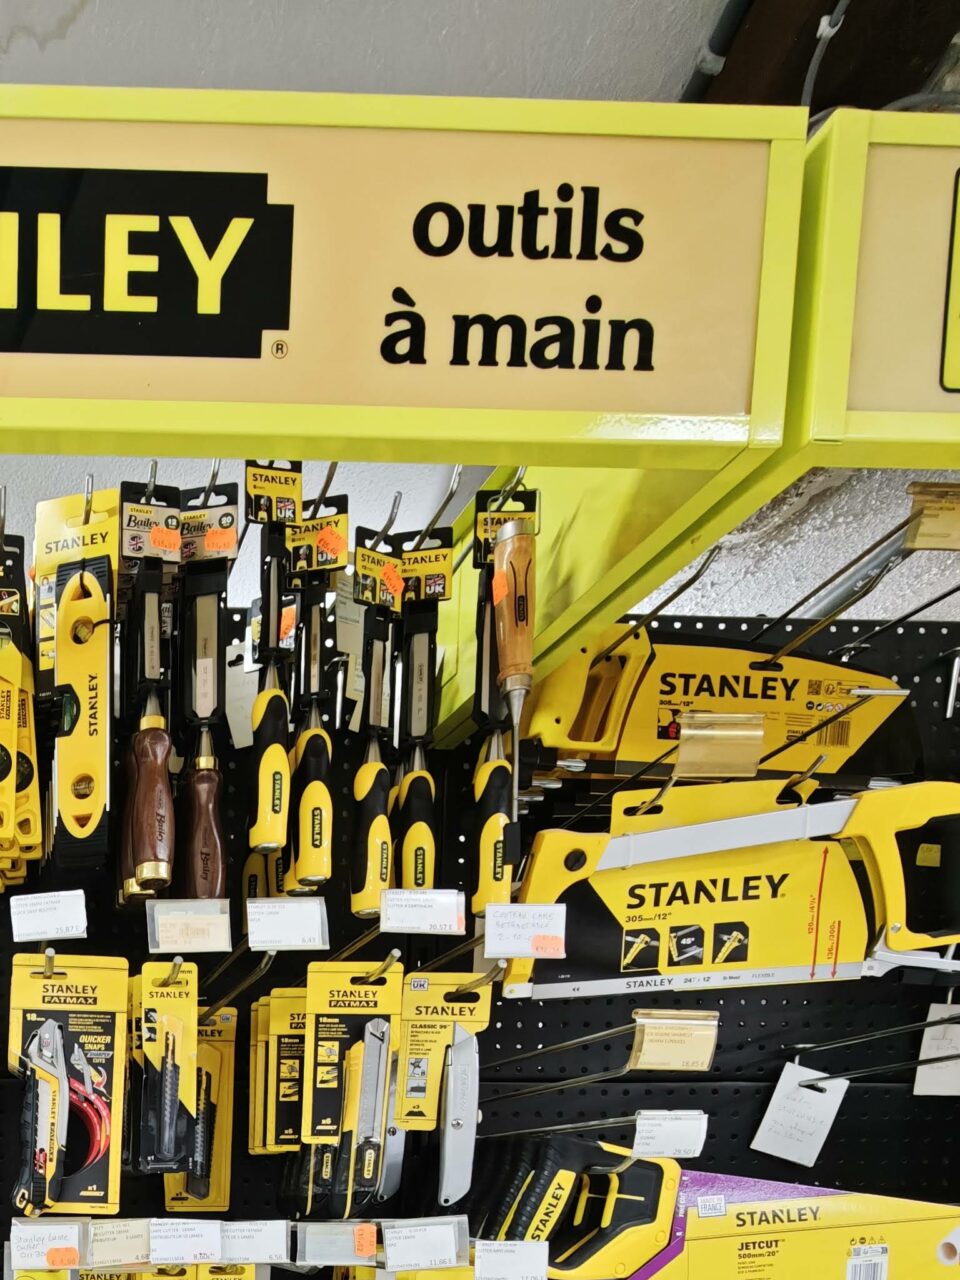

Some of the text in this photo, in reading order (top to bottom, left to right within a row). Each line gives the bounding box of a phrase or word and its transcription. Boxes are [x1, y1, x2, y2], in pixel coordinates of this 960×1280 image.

[412, 182, 644, 263] outils
[380, 287, 655, 372] à main
[252, 473, 297, 486] STANLEY
[167, 518, 177, 527] 12
[221, 516, 233, 526] 20
[45, 531, 109, 555] STANLEY
[402, 553, 449, 570] STANLEY
[659, 672, 800, 701] STANLEY
[88, 673, 98, 737] STANLEY
[273, 773, 282, 813] STANLEY
[312, 808, 322, 847] STANLEY
[380, 842, 388, 881] STANLEY
[416, 848, 425, 886] STANLEY
[494, 842, 503, 880] STANLEY
[626, 873, 790, 910] STANLEY
[42, 984, 98, 995] STANLEY
[625, 977, 674, 989] STANLEY
[43, 997, 97, 1005] FATMAX
[149, 990, 190, 999] STANLEY
[329, 989, 378, 999] STANLEY
[329, 1000, 376, 1008] FATMAX
[415, 1005, 476, 1017] STANLEY
[79, 1035, 111, 1044] QUICKER
[84, 1043, 106, 1051] SNAPS
[531, 1182, 564, 1241] STANLEY
[736, 1206, 820, 1228] STANLEY
[738, 1239, 779, 1251] JETCUT
